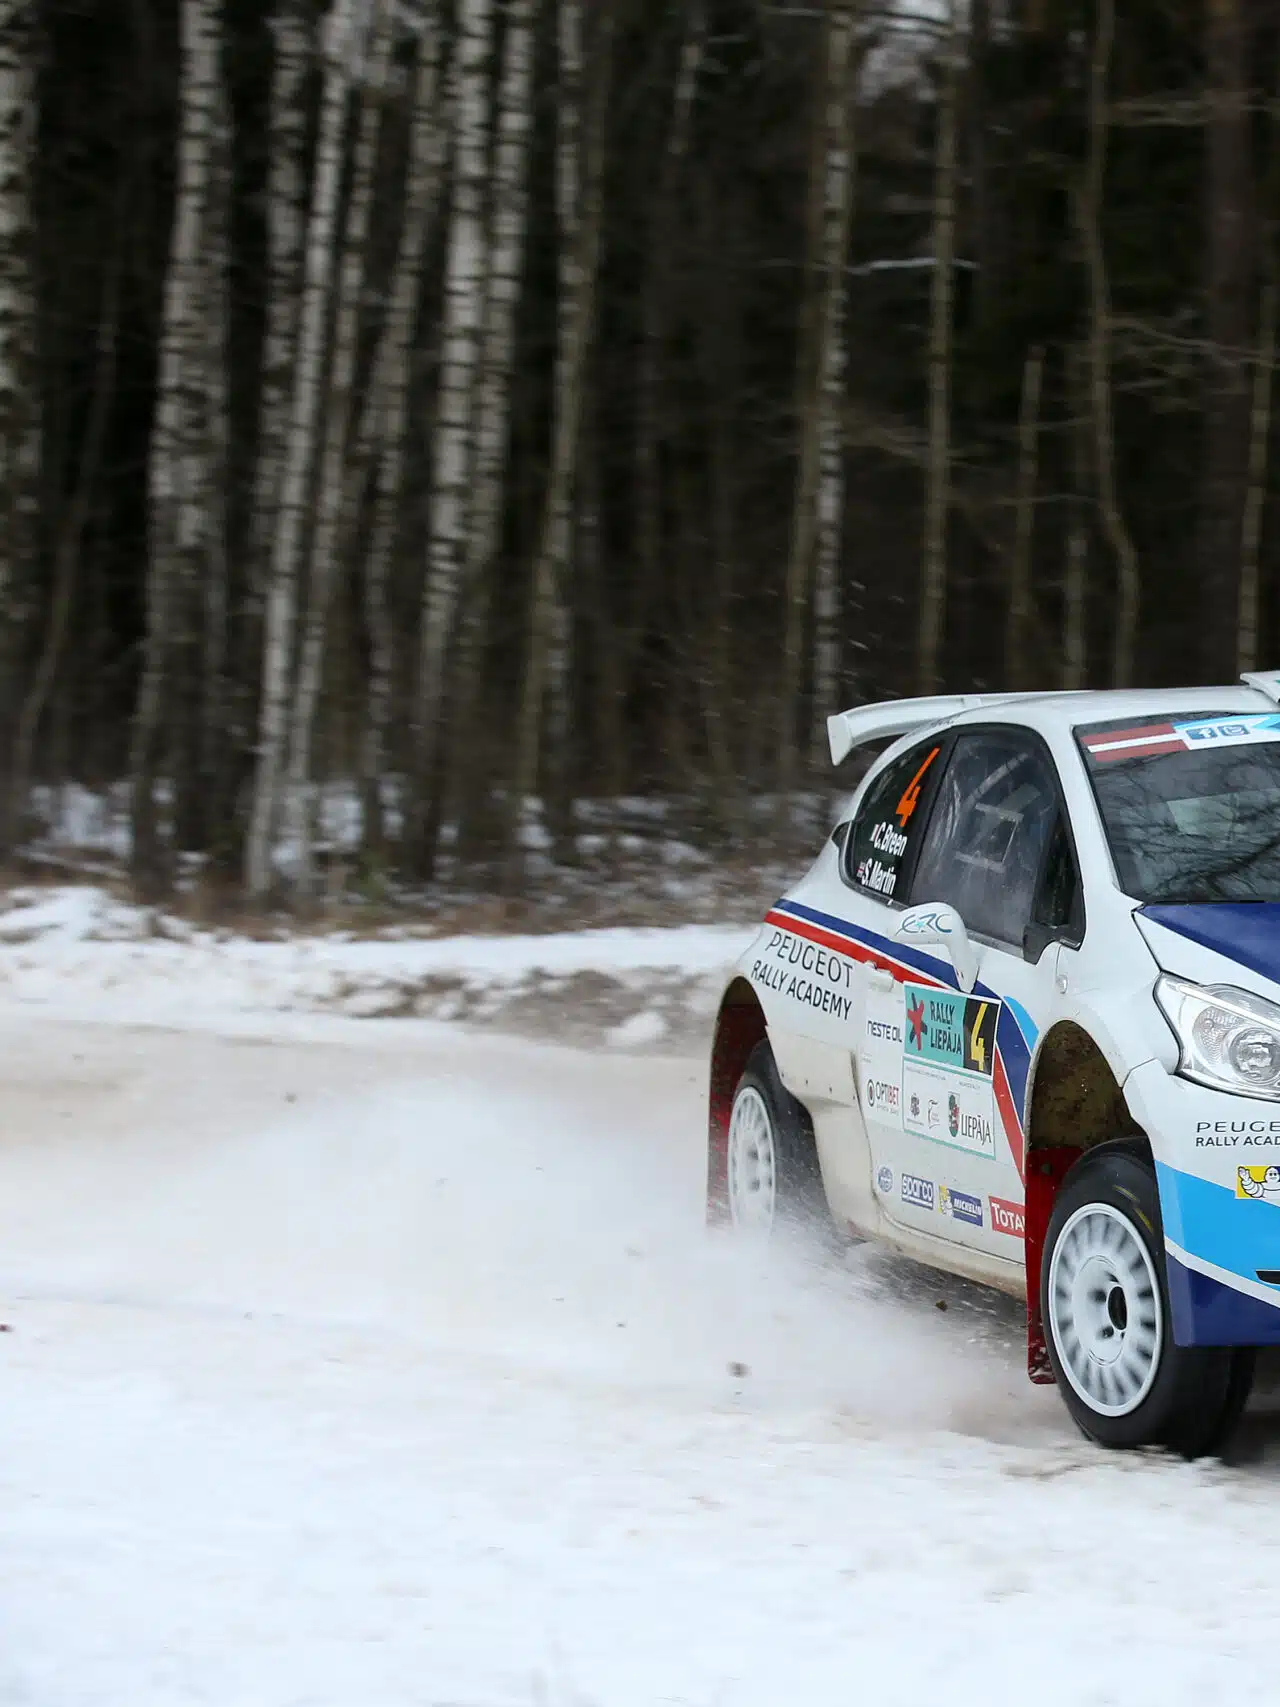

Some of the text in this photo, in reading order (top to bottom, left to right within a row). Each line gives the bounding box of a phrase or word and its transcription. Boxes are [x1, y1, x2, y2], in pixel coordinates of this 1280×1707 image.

[896, 748, 940, 827] 4
[765, 931, 853, 988] PEUGEOT
[751, 960, 852, 1020] RALLY ACADEMY
[929, 1001, 955, 1025] RALLY
[971, 1002, 989, 1071] 4
[875, 1081, 899, 1105] OPTIBET
[1195, 1136, 1239, 1147] RALLY
[953, 1198, 982, 1216] MICHELIN
